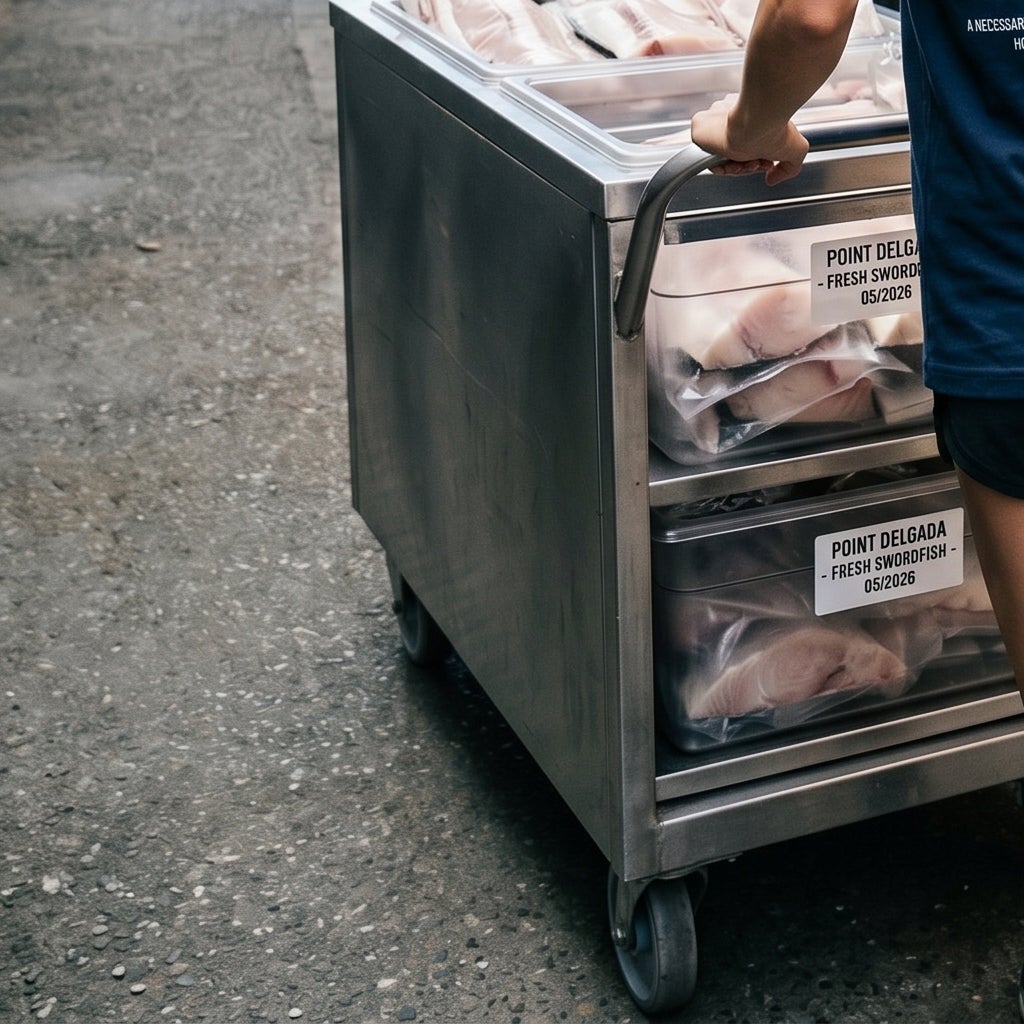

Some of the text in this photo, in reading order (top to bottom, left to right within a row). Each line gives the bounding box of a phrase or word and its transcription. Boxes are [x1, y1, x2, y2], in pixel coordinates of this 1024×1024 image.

[967, 19, 974, 32] A
[827, 244, 872, 268] POINT
[827, 270, 867, 289] FRESH
[861, 284, 912, 305] 05/2026
[832, 520, 947, 559] POINT DELGADA
[832, 559, 871, 580] FRESH
[875, 543, 947, 571] SWORDFISH
[864, 570, 916, 593] 05/2026
